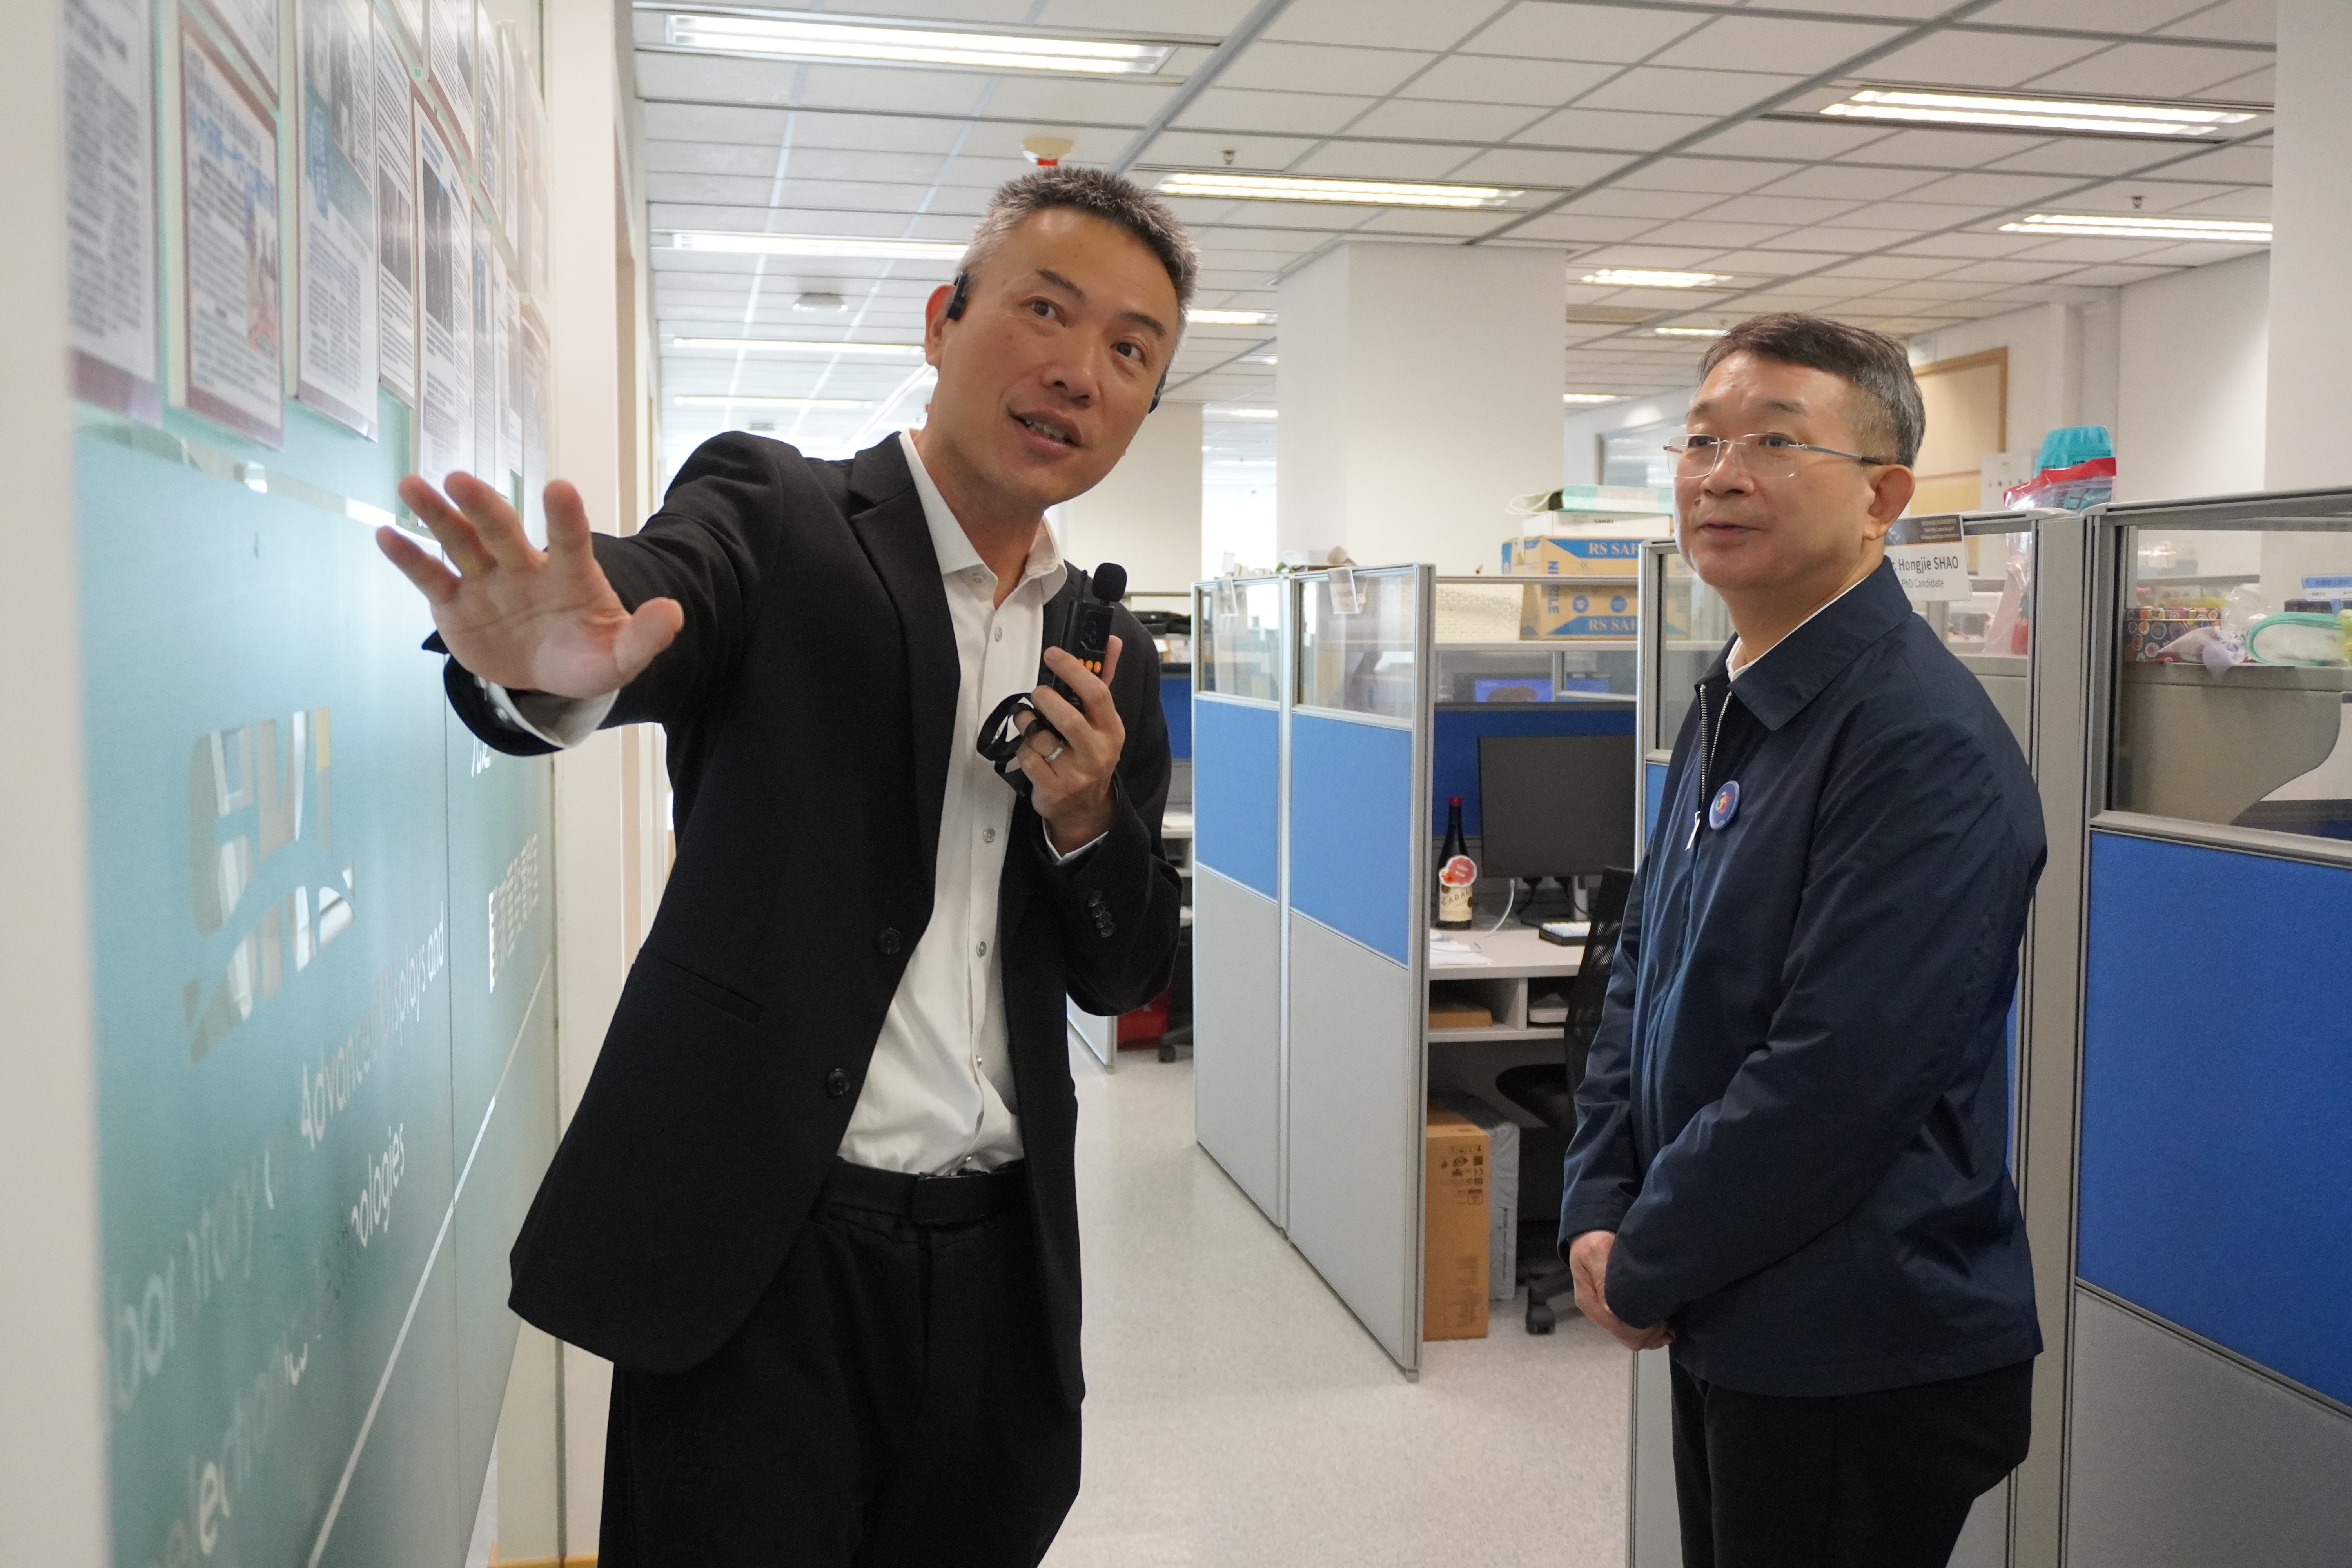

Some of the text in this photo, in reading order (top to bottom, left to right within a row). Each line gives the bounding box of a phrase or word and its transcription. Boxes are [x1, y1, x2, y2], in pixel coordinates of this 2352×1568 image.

[1589, 543, 1607, 555] RS
[1899, 556, 1931, 574] Hongjie
[1933, 555, 1958, 570] SHAO
[1548, 560, 1560, 614] NIRILE
[1902, 577, 1944, 588] PhD Candidate
[1589, 619, 1607, 631] RS
[380, 944, 426, 1046] Displays
[427, 901, 444, 983] and
